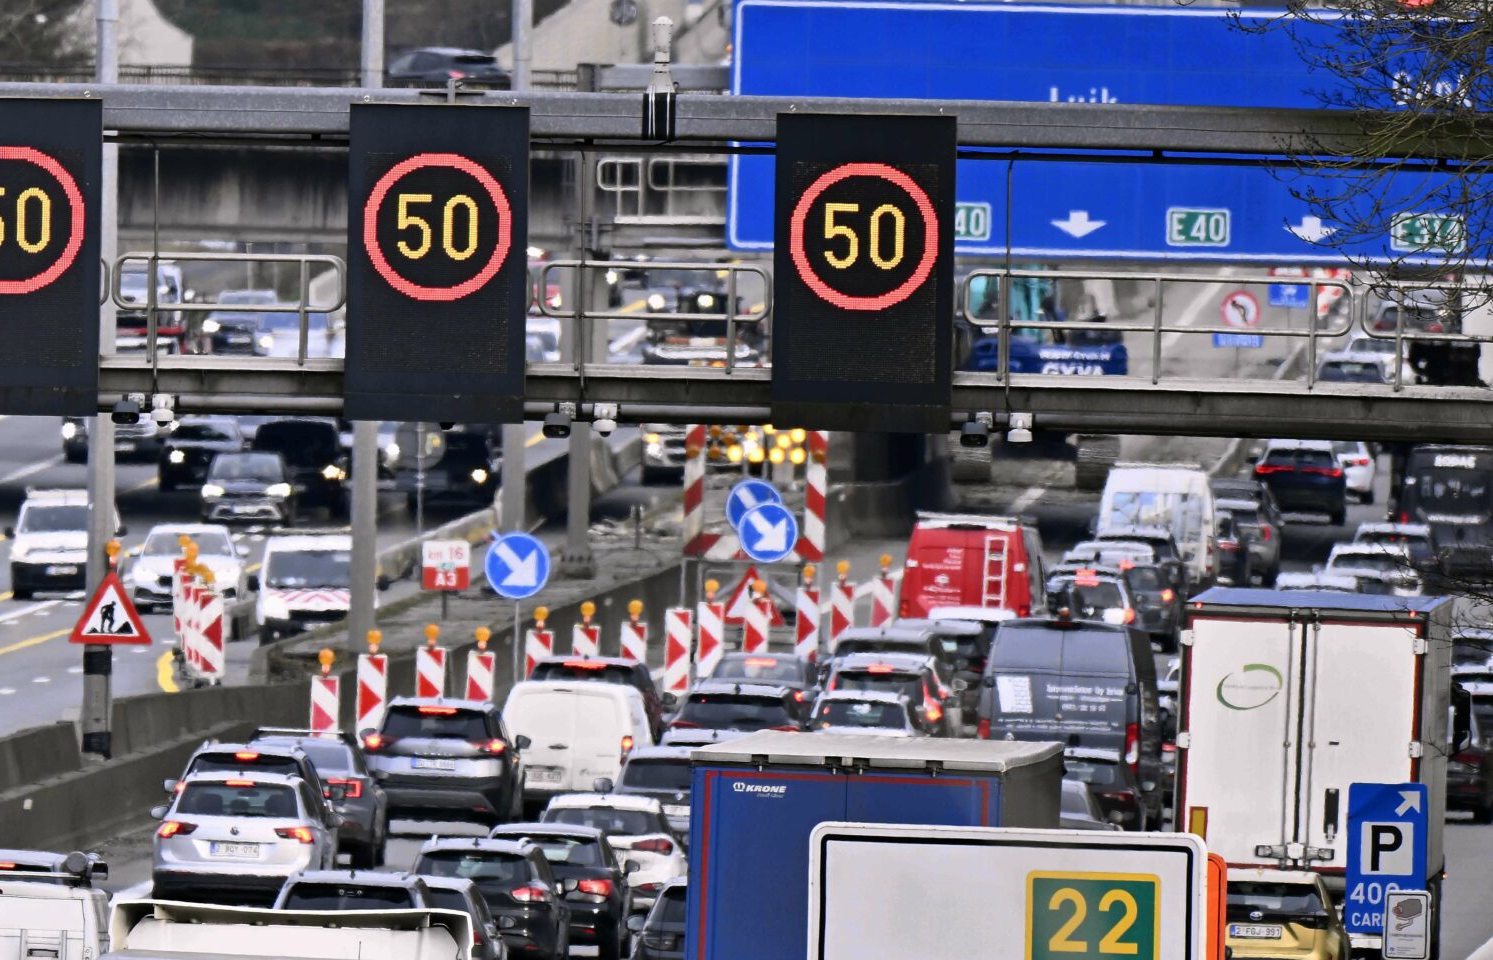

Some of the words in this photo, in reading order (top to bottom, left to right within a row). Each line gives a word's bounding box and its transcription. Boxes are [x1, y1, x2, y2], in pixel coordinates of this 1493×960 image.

[396, 193, 479, 261] 50
[823, 202, 906, 271] 50
[955, 207, 987, 238] 40
[746, 784, 787, 794] KRONE
[1370, 824, 1403, 872] P
[1047, 887, 1140, 955] 22
[1351, 912, 1386, 927] CAR
